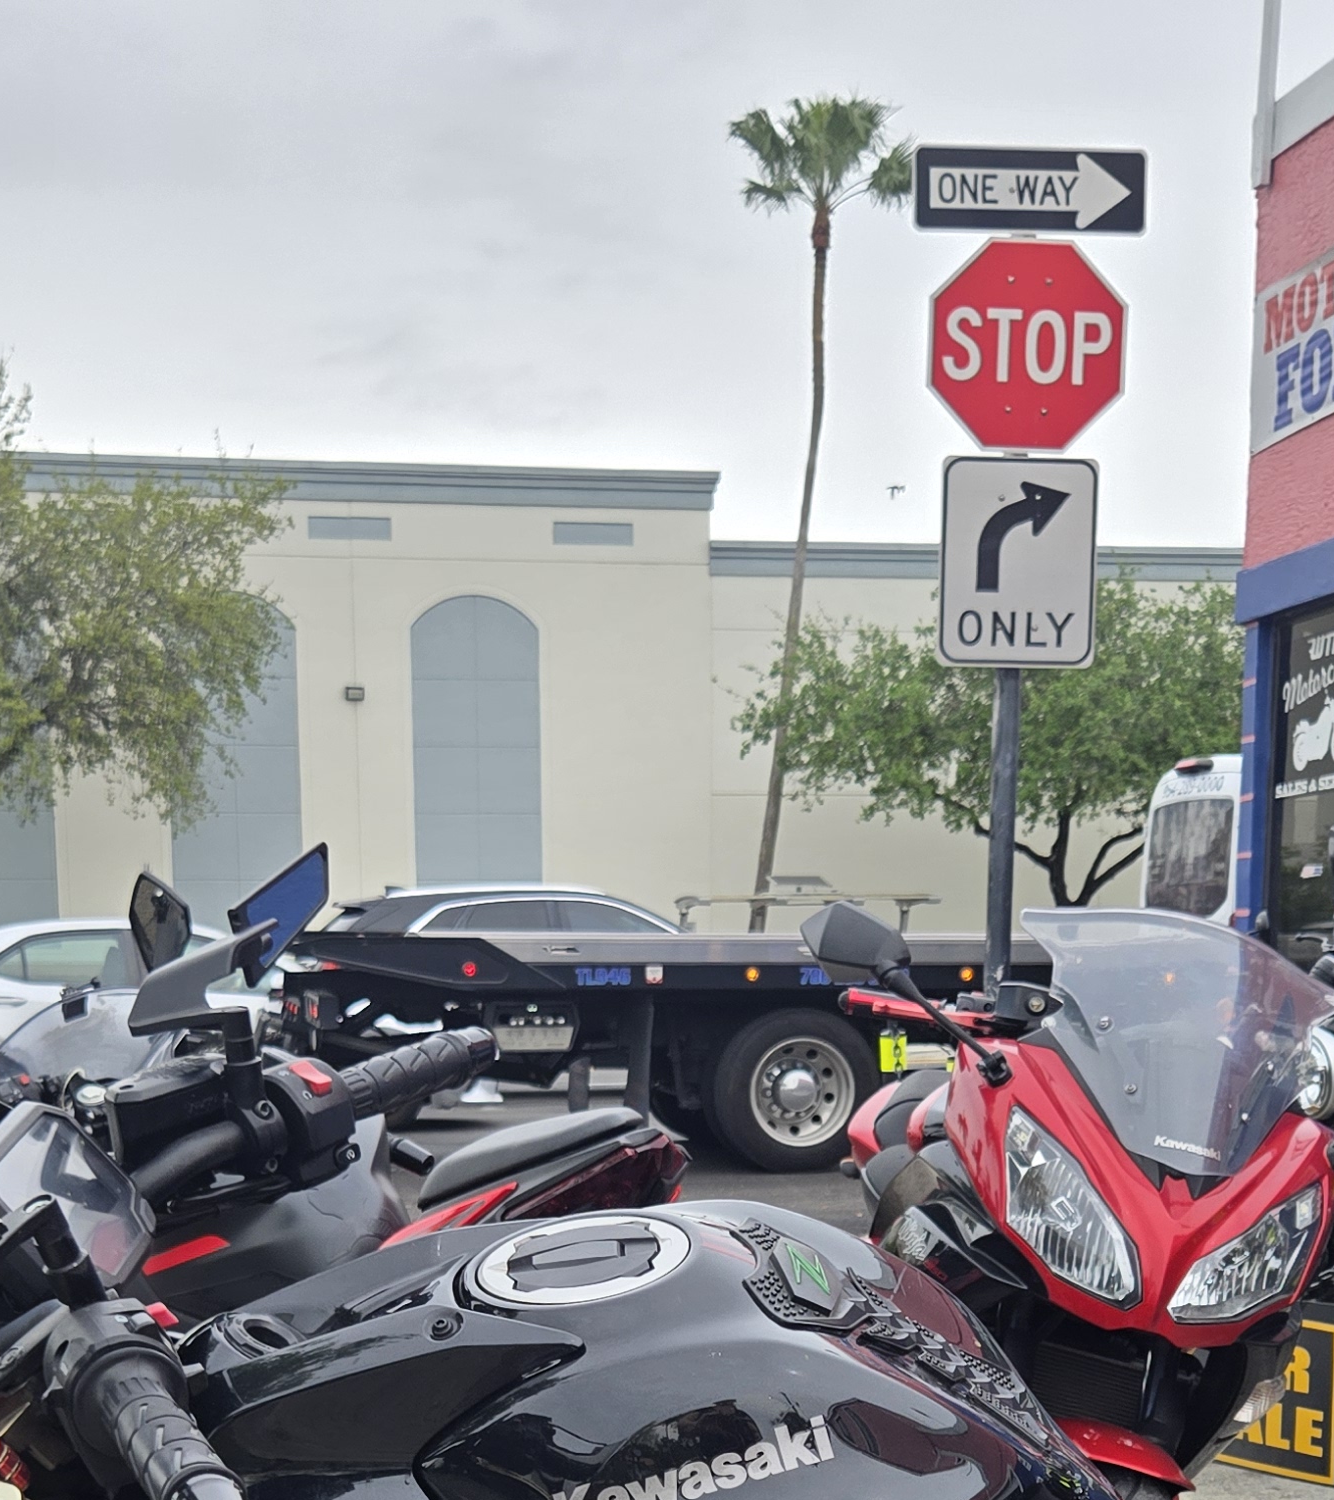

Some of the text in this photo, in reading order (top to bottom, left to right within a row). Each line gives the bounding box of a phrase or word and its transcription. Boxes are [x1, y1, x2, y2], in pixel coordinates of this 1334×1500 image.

[938, 173, 1079, 207] ONE WAY
[942, 306, 1113, 386] STOP
[957, 610, 1075, 648] ONLY
[1274, 780, 1308, 799] SALES
[1153, 1135, 1221, 1162] Kawasaki
[1235, 1402, 1324, 1458] ALE
